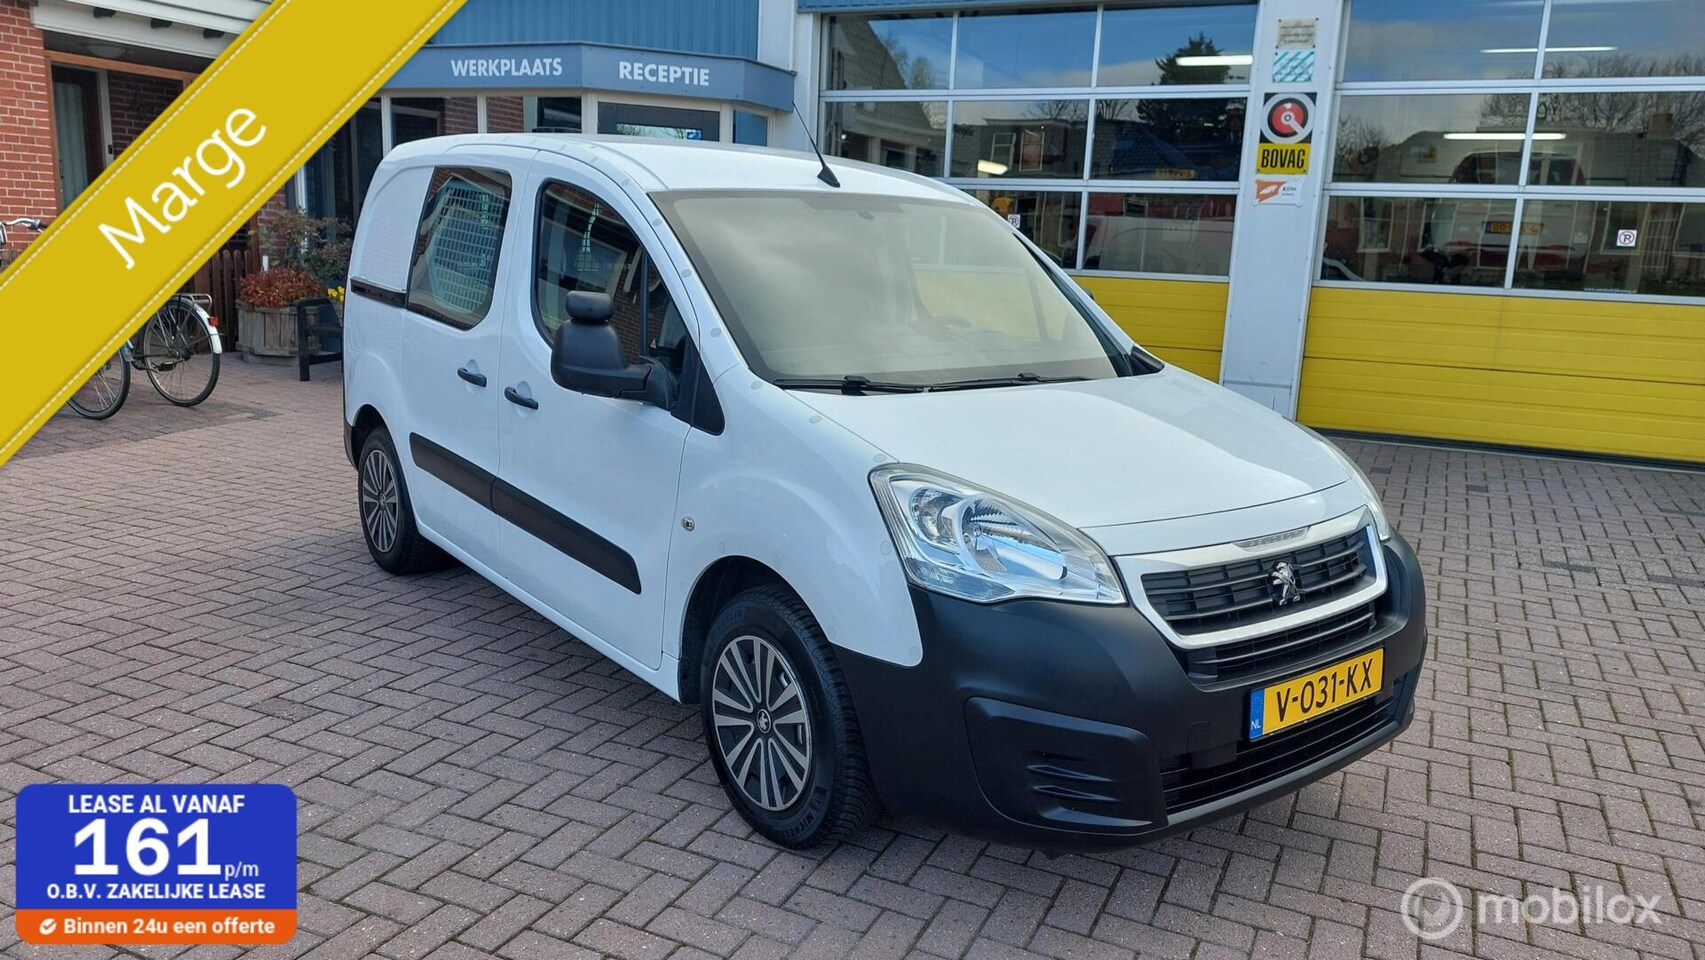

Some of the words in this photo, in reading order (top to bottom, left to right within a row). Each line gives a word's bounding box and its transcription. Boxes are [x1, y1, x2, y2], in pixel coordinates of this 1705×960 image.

[451, 58, 562, 77] WERKPLAATS
[619, 61, 709, 86] RECEPTIE
[1261, 149, 1305, 169] BOVAG
[1276, 658, 1373, 722] V-031-KX
[1251, 718, 1261, 730] NL
